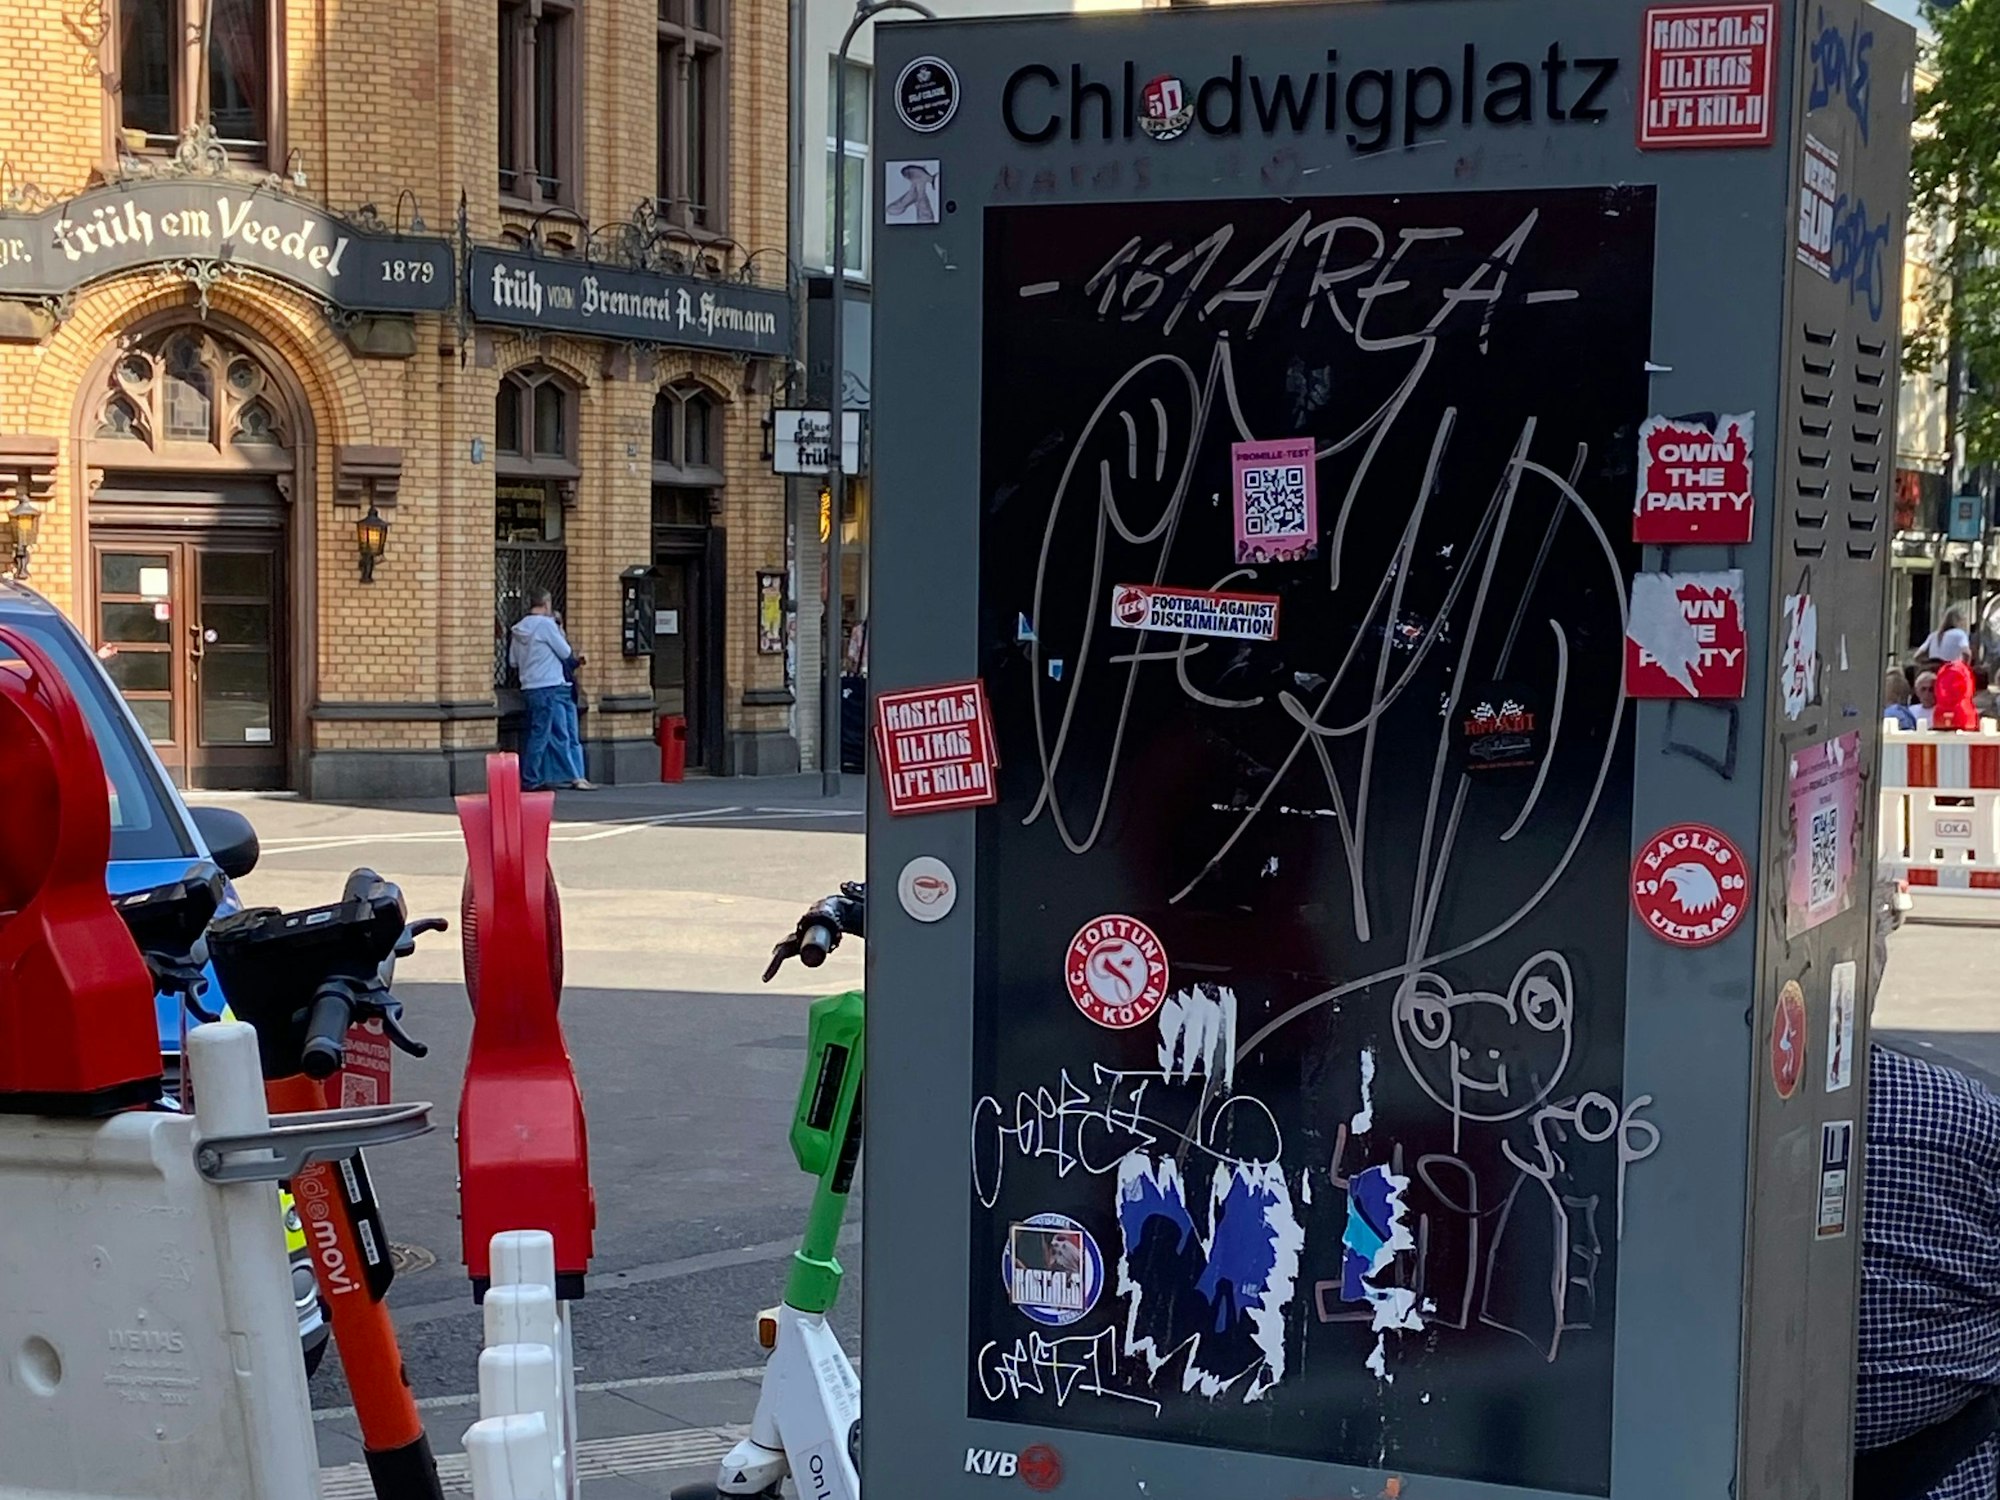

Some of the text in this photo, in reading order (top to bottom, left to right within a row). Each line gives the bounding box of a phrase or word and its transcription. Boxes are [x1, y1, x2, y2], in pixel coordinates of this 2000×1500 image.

[1661, 56, 1752, 88] ULTRAS
[1002, 41, 1619, 152] Chldwigplatz
[161, 208, 212, 238] em
[216, 197, 349, 277] Veedel
[381, 259, 434, 283] 1879
[580, 275, 671, 323] Brennerei
[675, 287, 697, 332] A.
[698, 291, 776, 338] Hermann
[1236, 448, 1310, 461] PROMILLE-TEST
[1658, 443, 1734, 463] OWN
[1665, 467, 1725, 487] THE
[1646, 491, 1750, 512] PARTY
[1152, 596, 1275, 618] FOOTBALL AGAINST
[1151, 611, 1273, 634] DISCRIMINATION
[1639, 647, 1744, 668] PTY
[1937, 821, 1970, 836] LOKA
[1643, 832, 1733, 871] EAGLES
[1635, 874, 1745, 895] 19 86
[1650, 902, 1738, 940] ULTRAS
[1075, 920, 1164, 977] FORTUNA
[1102, 986, 1161, 1024] KÖLN
[964, 1447, 1019, 1478] KVB
